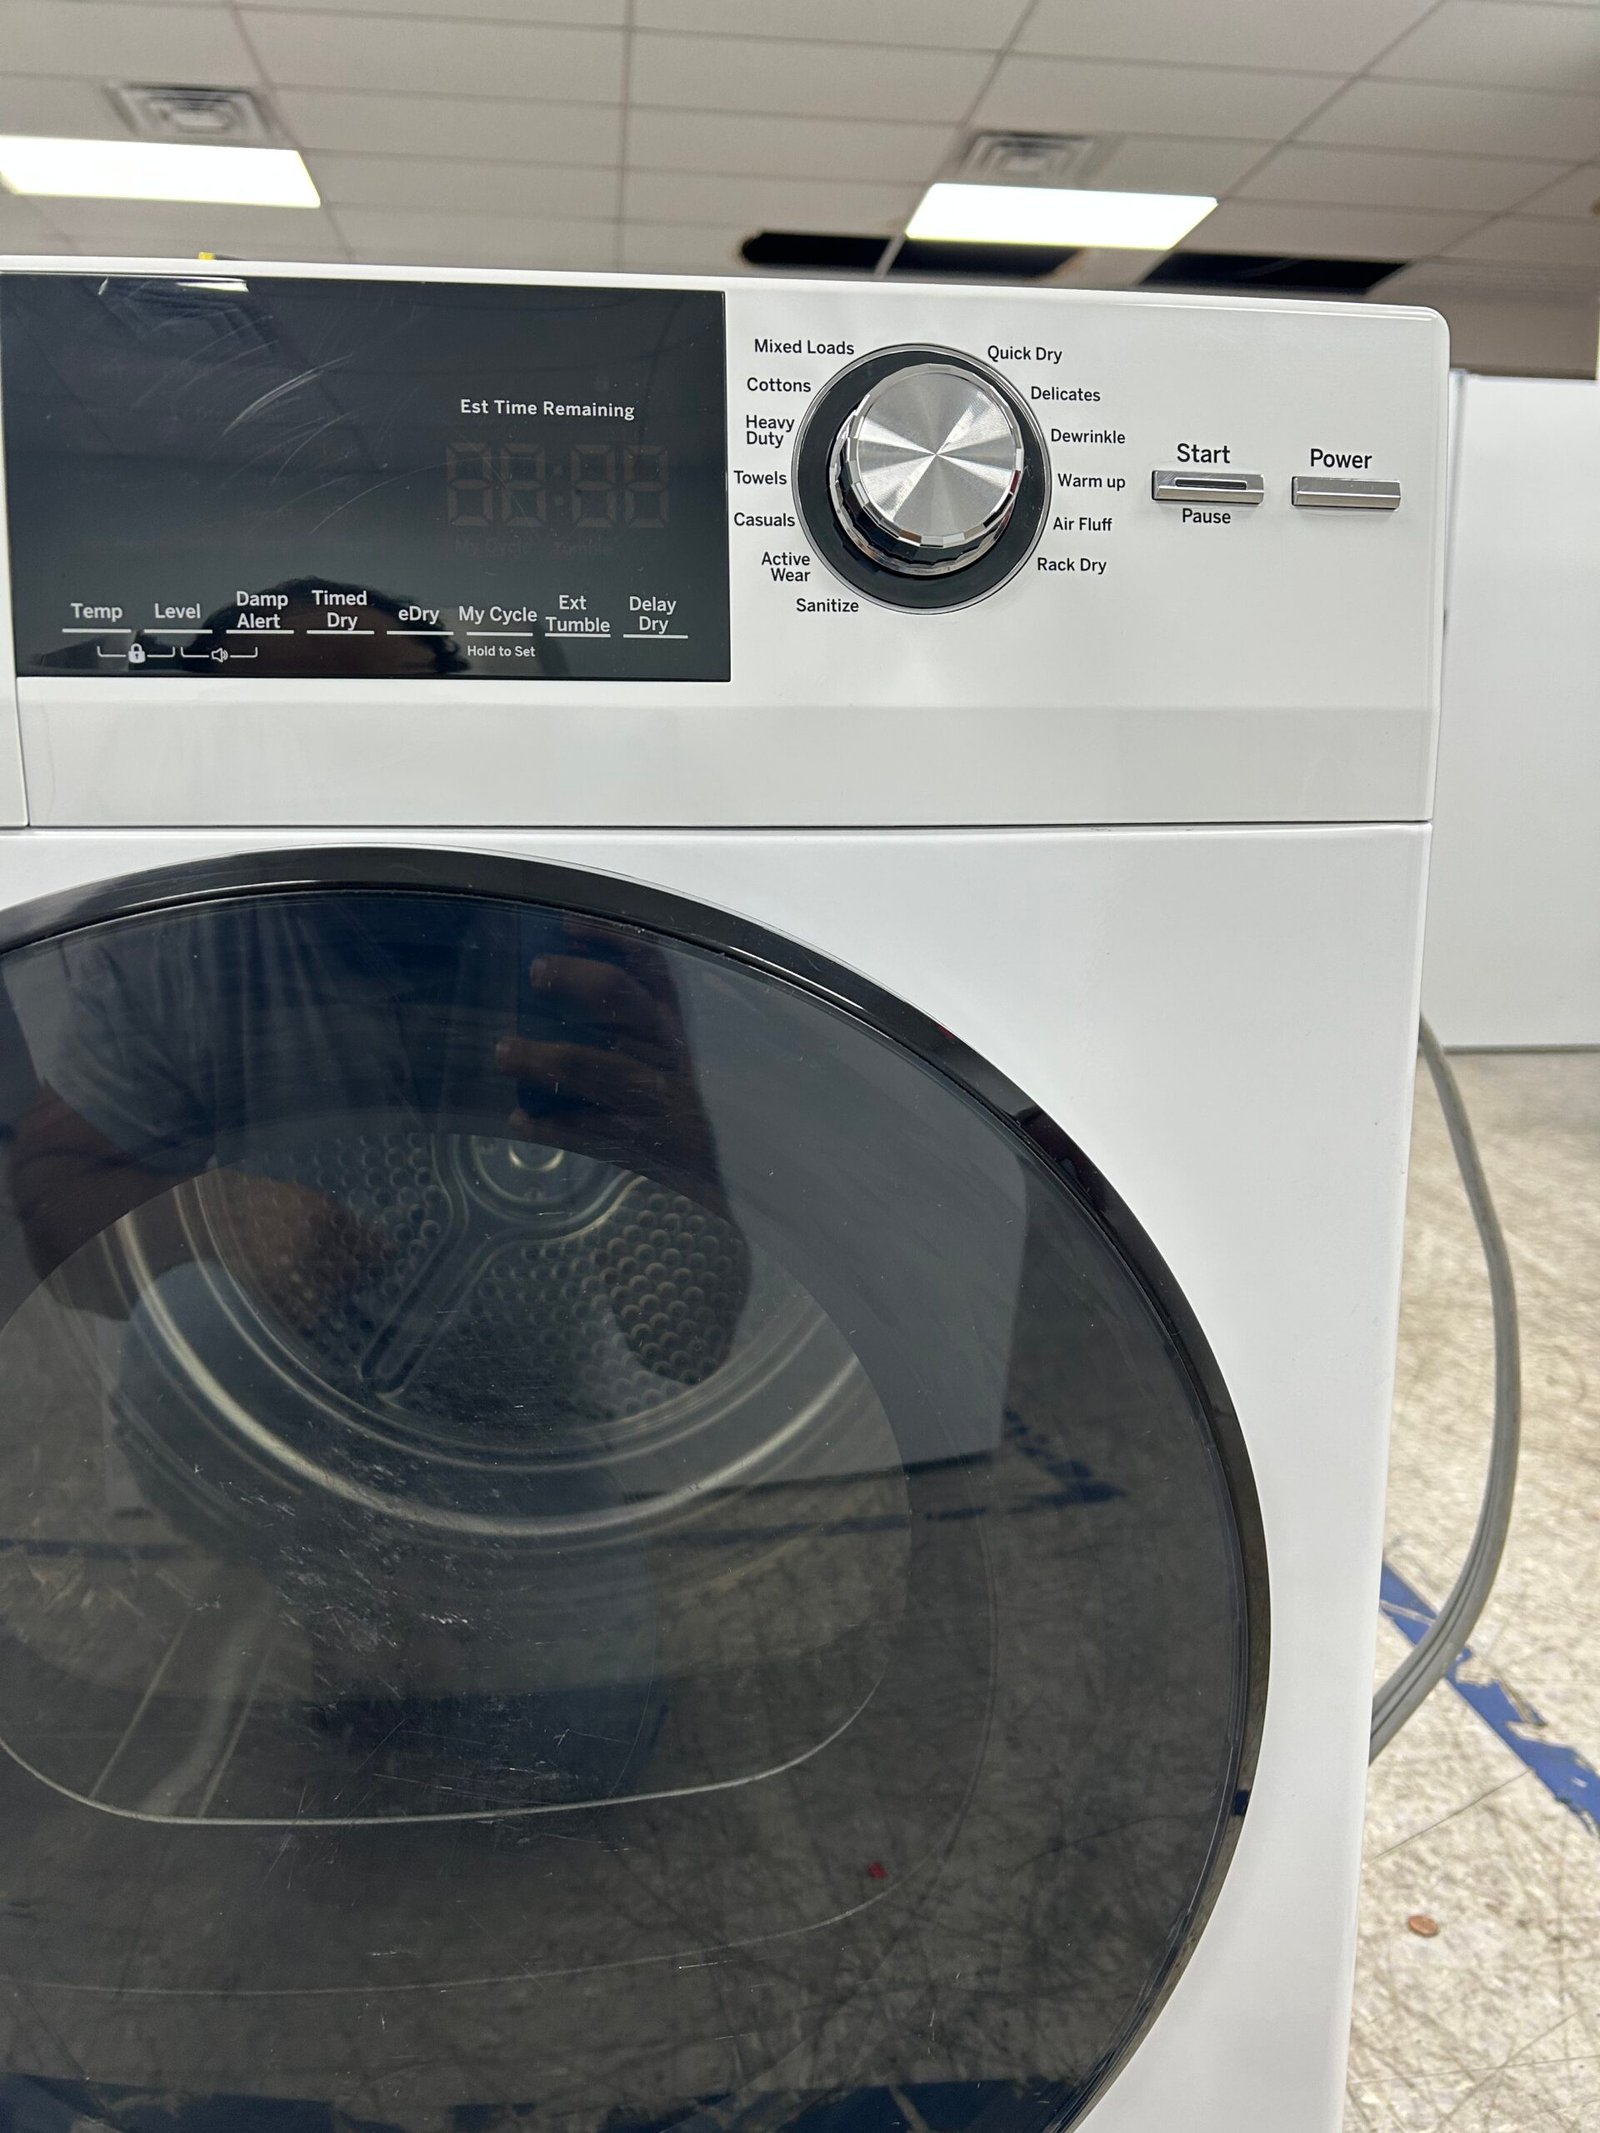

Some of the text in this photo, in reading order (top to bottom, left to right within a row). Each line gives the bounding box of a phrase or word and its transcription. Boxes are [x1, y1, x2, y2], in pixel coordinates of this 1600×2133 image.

[754, 338, 855, 355] Mixed Loads
[987, 345, 1063, 365] Quick Dry
[746, 377, 812, 393] Cottons
[1030, 385, 1101, 402] Delicates
[460, 398, 635, 421] Est Time Remaining
[746, 414, 795, 432] Heavy
[746, 431, 784, 449] Duty
[1051, 428, 1126, 444] Dewrinkle
[1177, 442, 1231, 464] Start
[1310, 448, 1373, 469] Power
[733, 470, 788, 485] Towels
[1057, 473, 1126, 492] Warm up
[733, 511, 796, 527] Casuals
[1052, 516, 1113, 532] Air Fluff
[1182, 507, 1231, 524] Pause
[761, 551, 811, 567] Active
[1037, 557, 1107, 575] Rack Dry
[770, 566, 811, 582] Wear
[236, 590, 289, 610] Damp
[311, 589, 368, 606] Timed
[559, 594, 587, 610] Ext
[629, 596, 677, 614] Delay
[796, 597, 860, 613] Sanitize
[70, 602, 123, 622] Temp
[154, 602, 201, 619] Level
[398, 605, 440, 625] eDry
[458, 605, 538, 626] My Cycle
[236, 612, 281, 629] Alert
[326, 612, 359, 631] Dry
[545, 616, 611, 633] Tumble
[639, 615, 669, 634] Dry
[467, 645, 536, 657] Hold to Set
